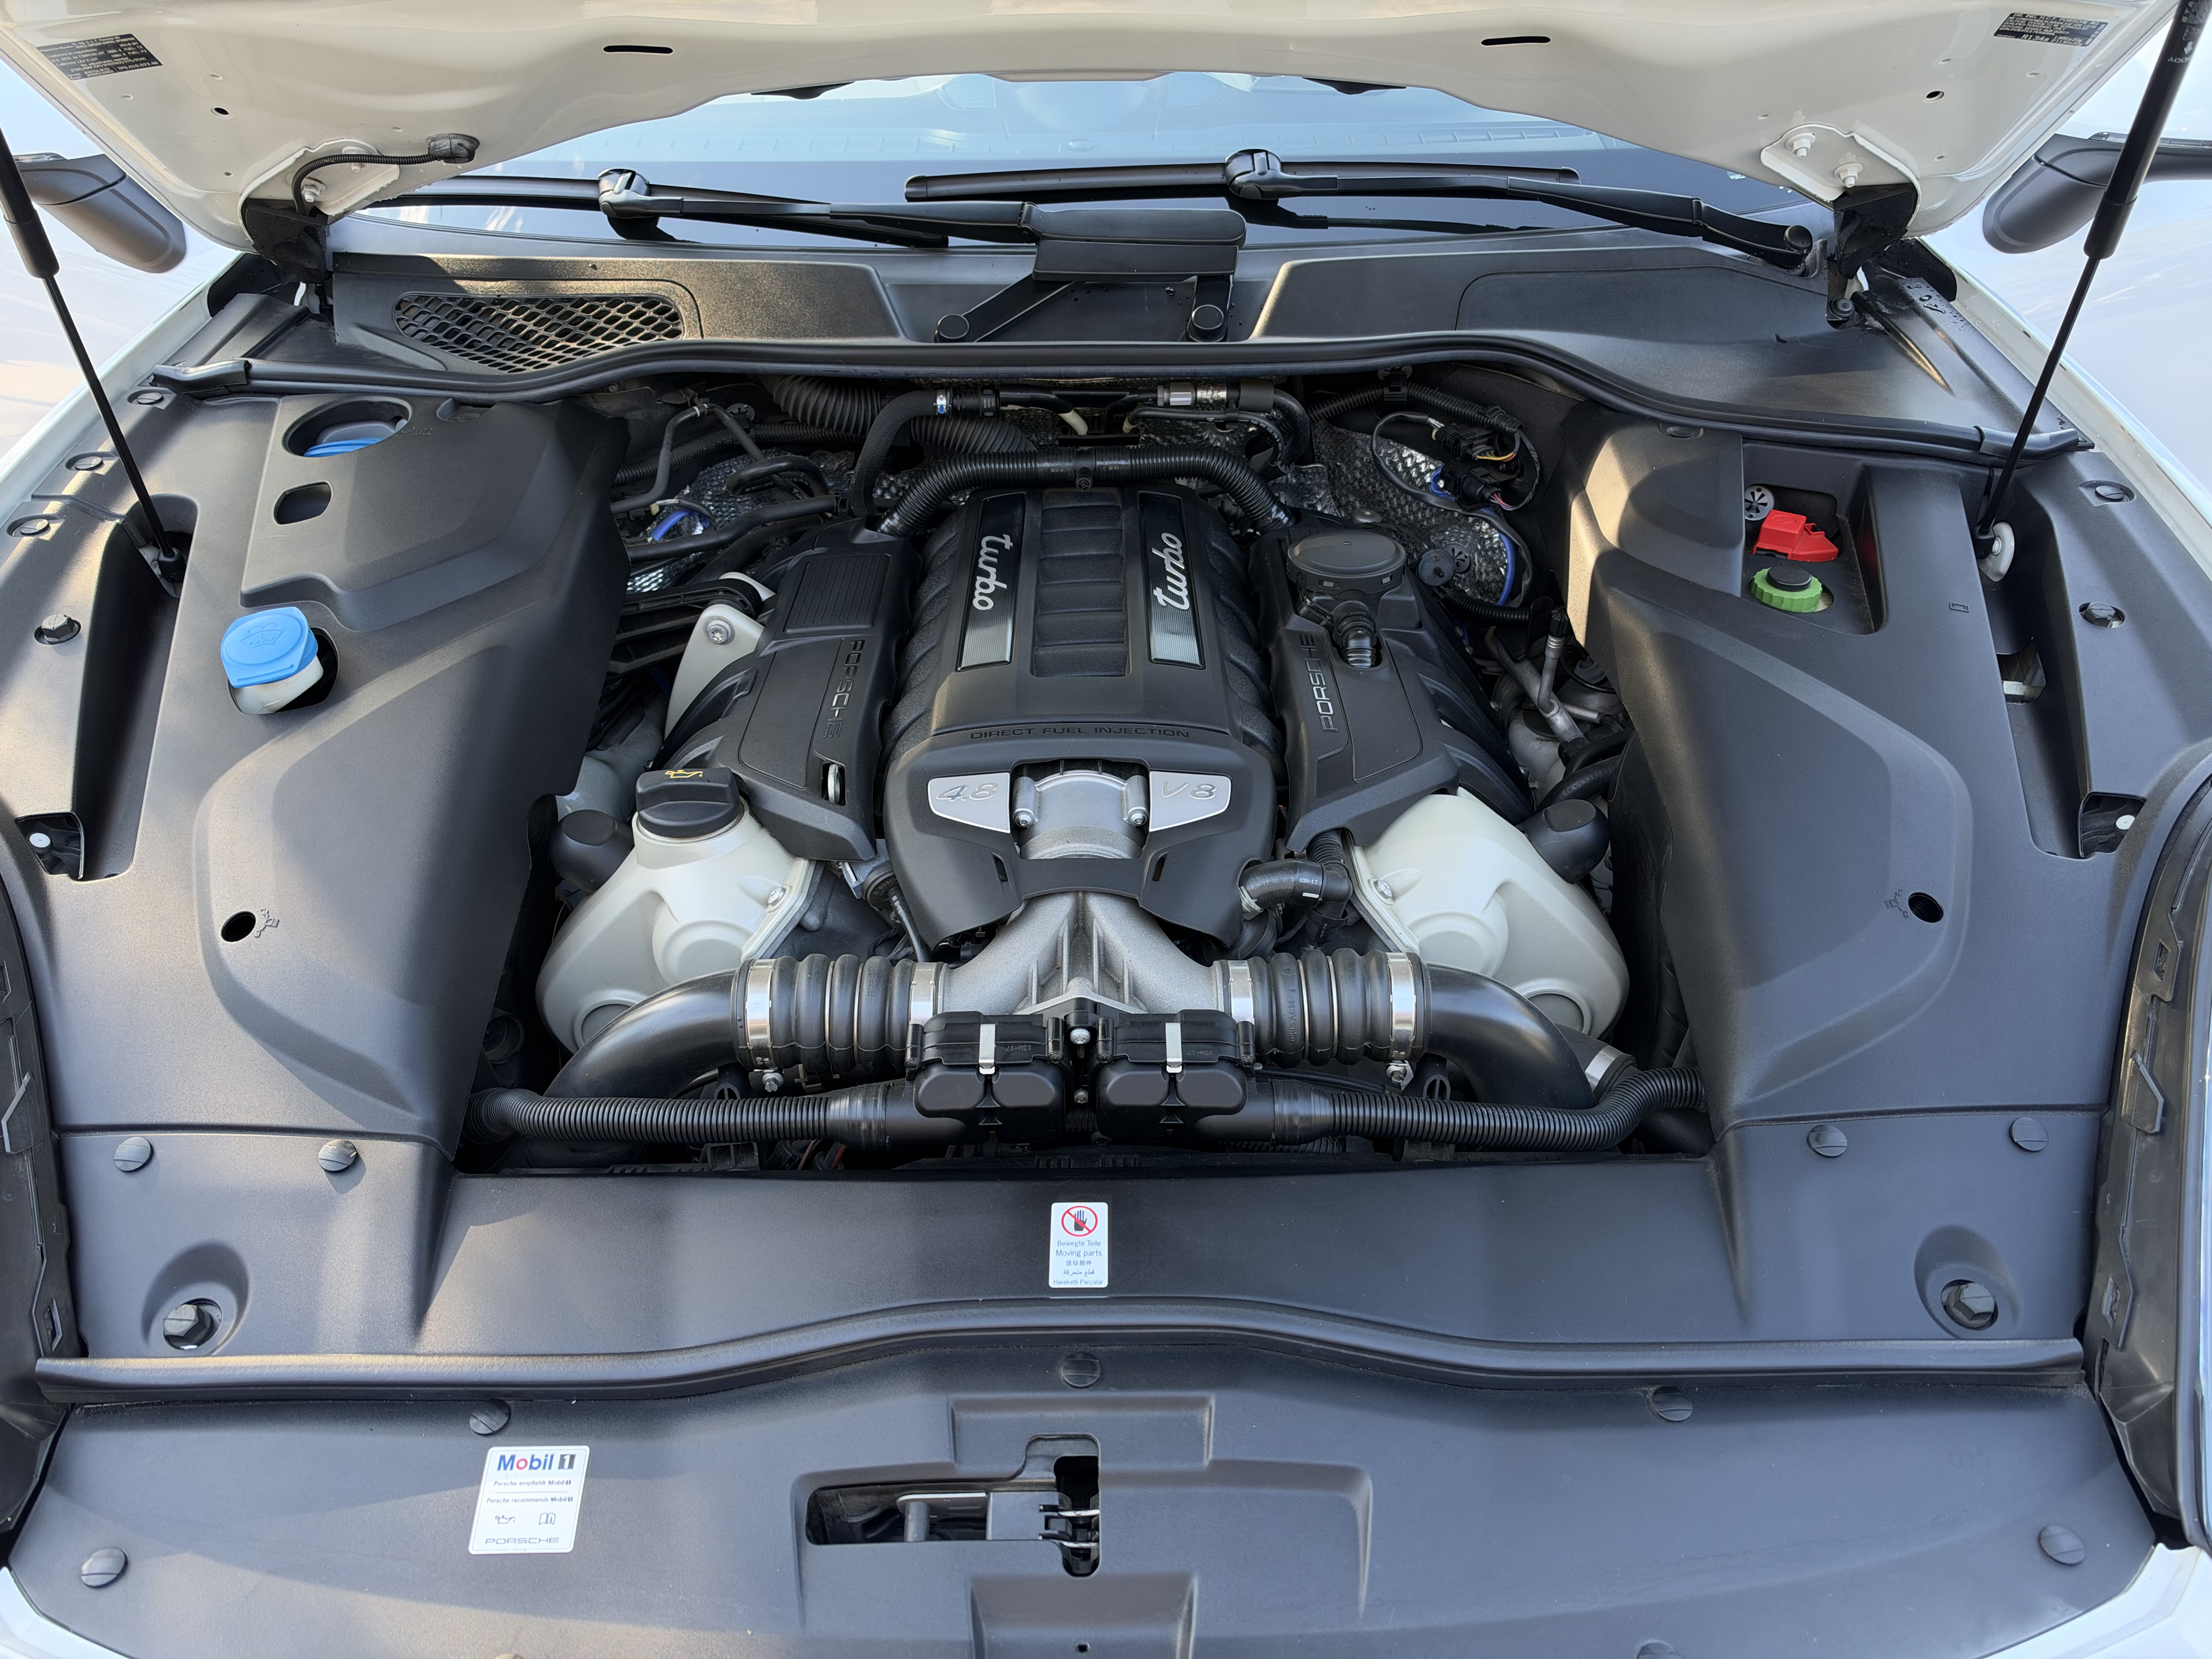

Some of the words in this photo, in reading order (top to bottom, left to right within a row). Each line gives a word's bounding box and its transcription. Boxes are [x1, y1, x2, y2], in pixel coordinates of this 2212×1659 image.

[972, 534, 1013, 611] turbo
[1152, 532, 1190, 610] turbo
[823, 639, 865, 738] PORSCHE
[1299, 634, 1338, 733] PORSCHE
[970, 727, 1036, 739] DIRECT
[1042, 726, 1087, 734] FUEL
[1094, 726, 1190, 738] INJECTION
[936, 783, 998, 802] 4.8
[1161, 781, 1217, 800] V8
[1056, 1249, 1081, 1257] Moving
[497, 1454, 555, 1471] Mobil
[485, 1537, 560, 1545] PORSCHE
